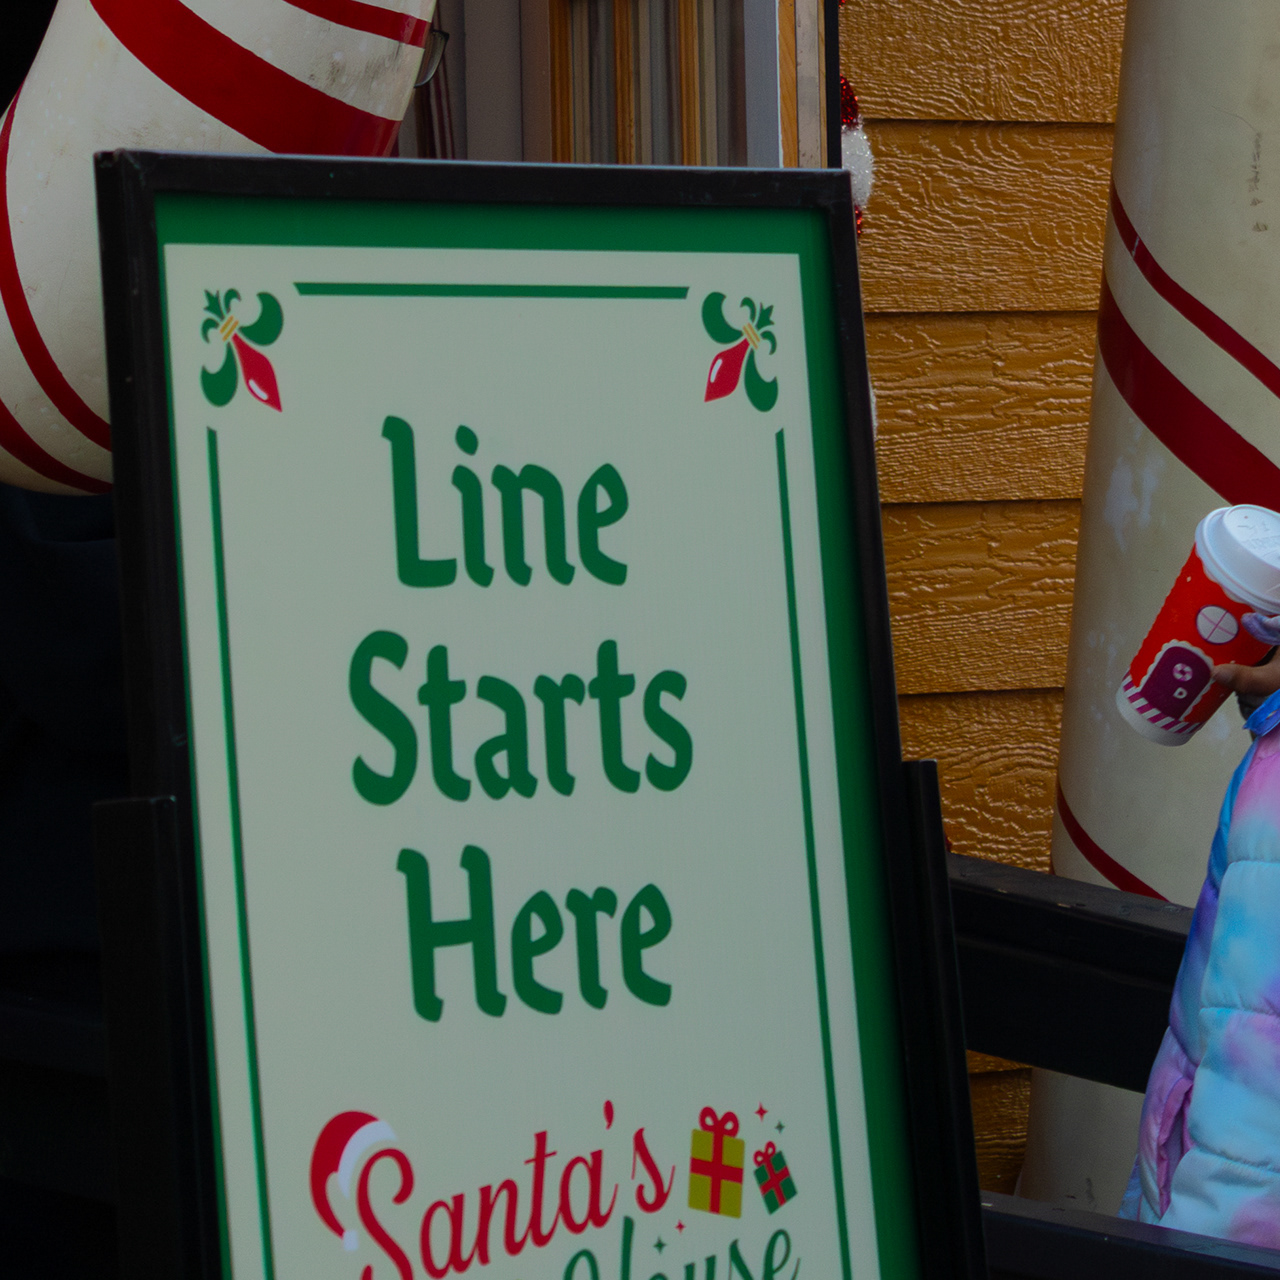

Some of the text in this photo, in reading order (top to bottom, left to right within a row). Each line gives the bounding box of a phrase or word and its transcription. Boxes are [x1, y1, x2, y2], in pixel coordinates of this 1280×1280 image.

[381, 415, 629, 589] Line
[349, 629, 694, 807] Starts
[397, 845, 674, 1023] Here
[356, 1100, 676, 1280] Santa's
